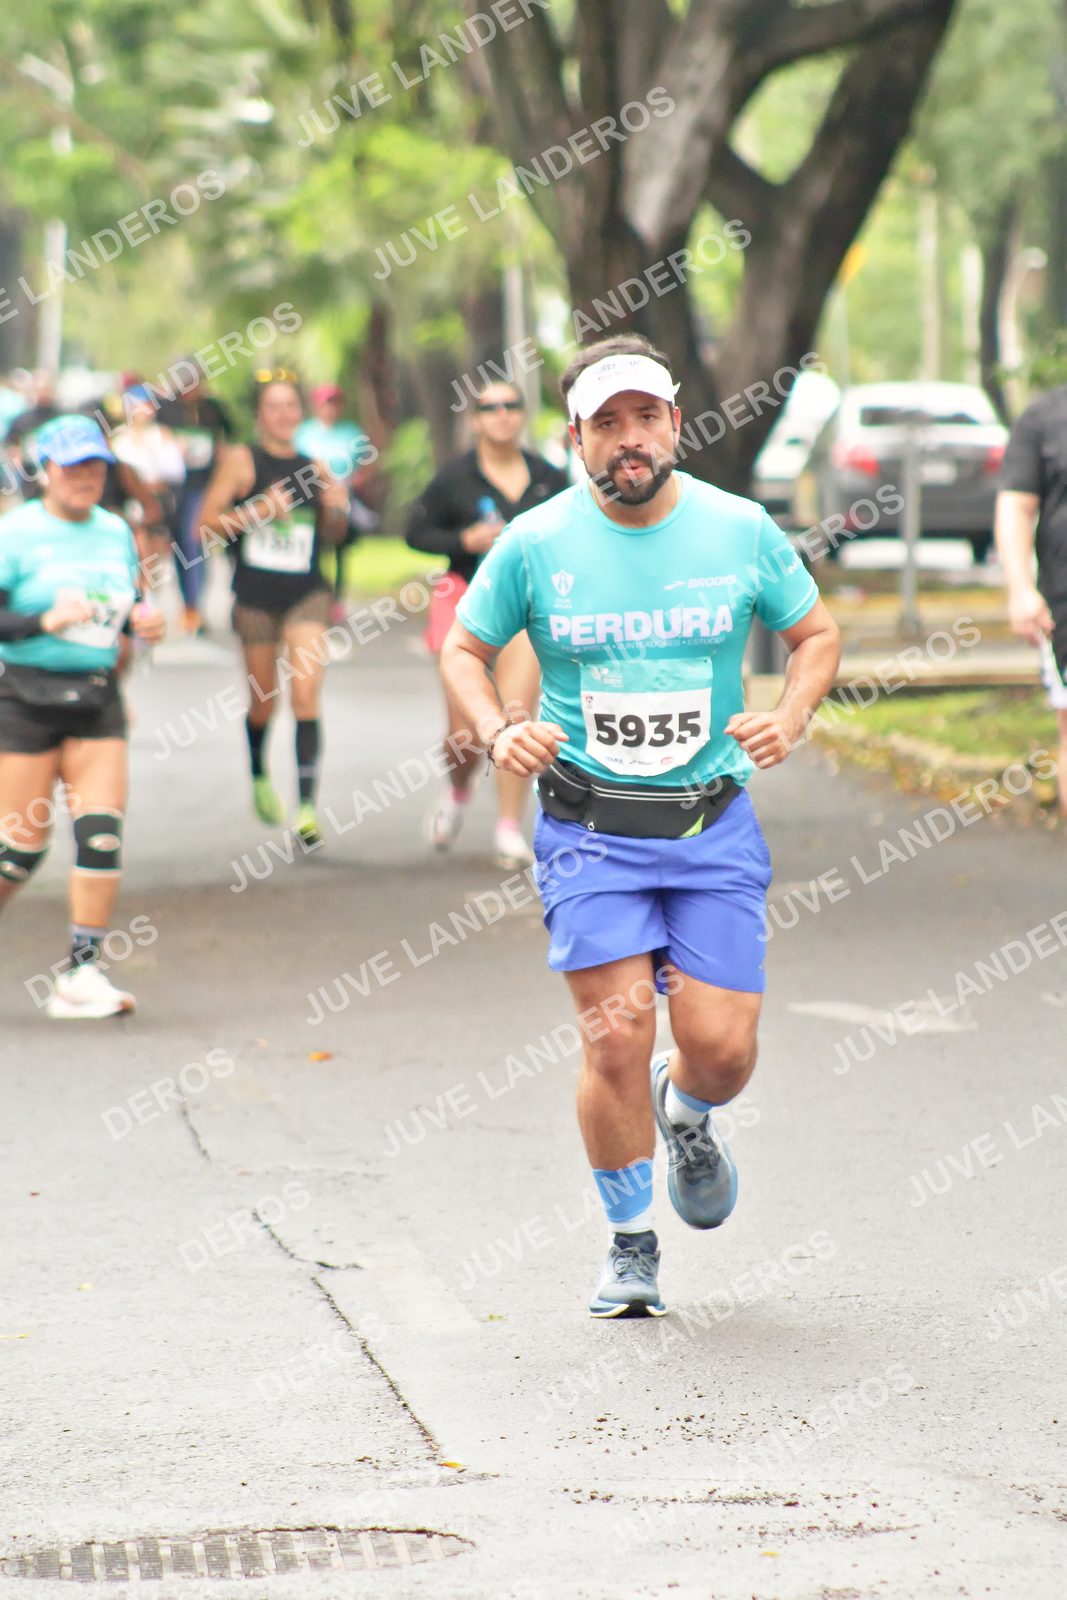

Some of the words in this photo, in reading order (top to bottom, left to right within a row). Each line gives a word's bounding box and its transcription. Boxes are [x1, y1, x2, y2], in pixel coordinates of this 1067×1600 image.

[688, 575, 737, 589] BROOKS
[549, 605, 733, 645] PERDURA
[594, 711, 701, 748] 5935
